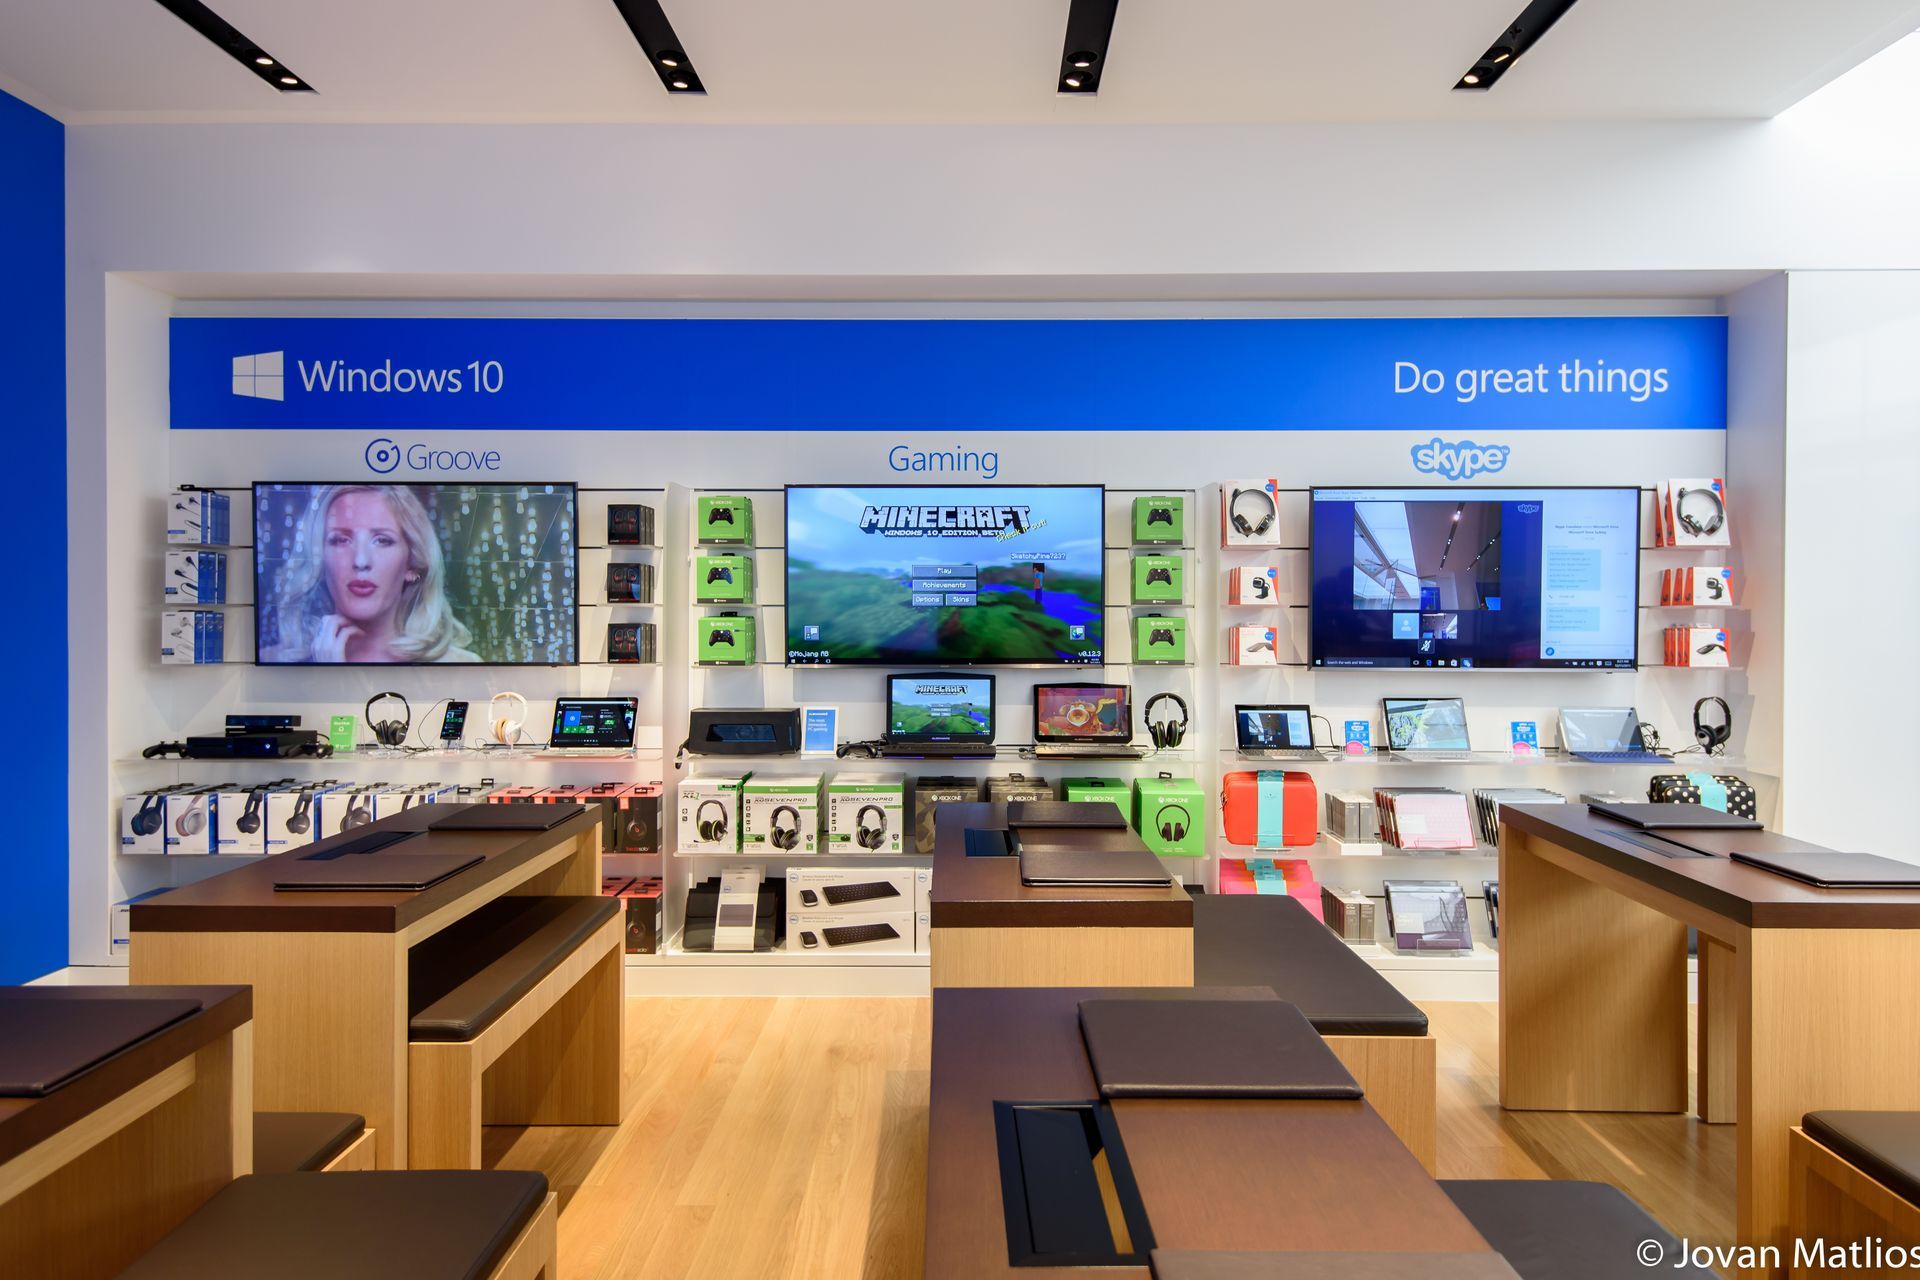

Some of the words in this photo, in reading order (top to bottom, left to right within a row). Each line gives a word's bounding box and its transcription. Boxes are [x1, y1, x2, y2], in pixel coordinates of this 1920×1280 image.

[297, 359, 462, 393] Windows
[467, 360, 504, 393] 10
[1394, 361, 1445, 394] Do
[1455, 362, 1548, 403] great
[1558, 359, 1669, 402] things
[406, 444, 501, 470] Groove
[888, 445, 999, 479] Gaming
[1416, 442, 1503, 476] skype
[859, 505, 1030, 532] MINECRAFT
[937, 567, 952, 575] Play
[922, 581, 966, 589] Achievements
[915, 596, 940, 604] Options
[915, 684, 968, 694] MINECRAFT
